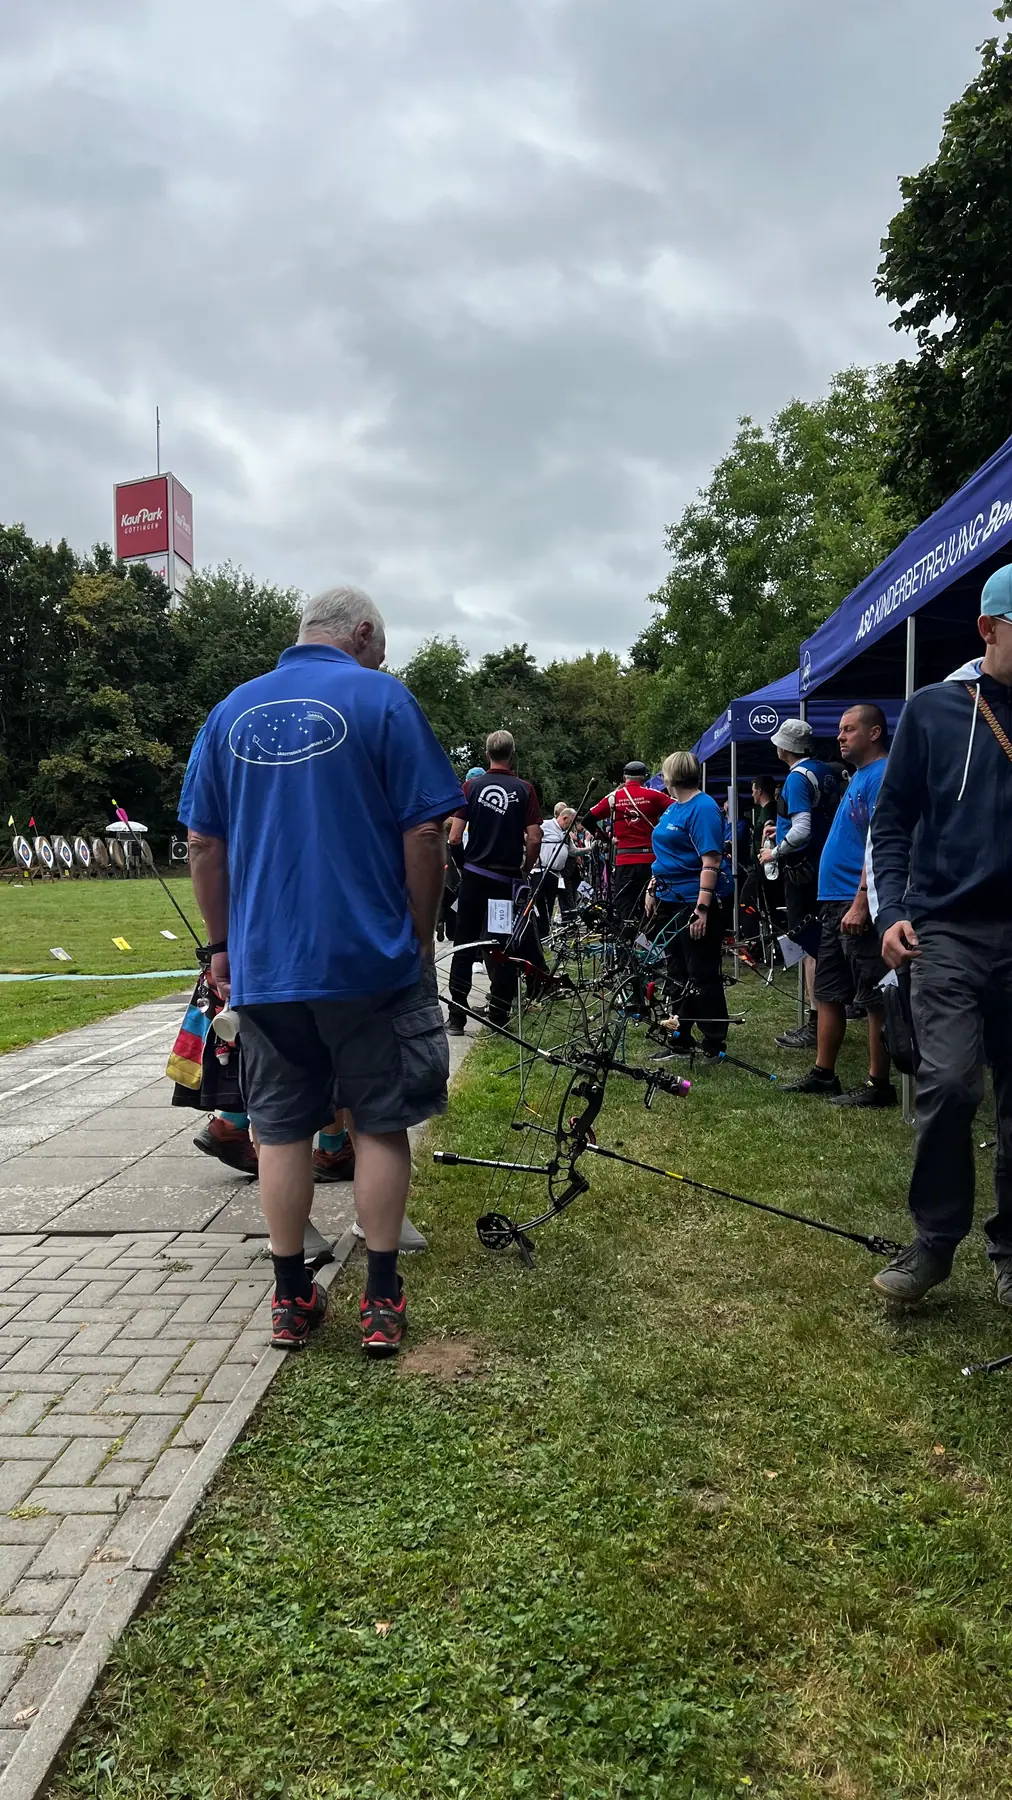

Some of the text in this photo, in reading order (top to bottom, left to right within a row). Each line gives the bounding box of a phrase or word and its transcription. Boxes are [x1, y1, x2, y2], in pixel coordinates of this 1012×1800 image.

[855, 604, 875, 642] ASC
[874, 513, 984, 627] KINDERBETREUUNG
[752, 714, 776, 724] ASC
